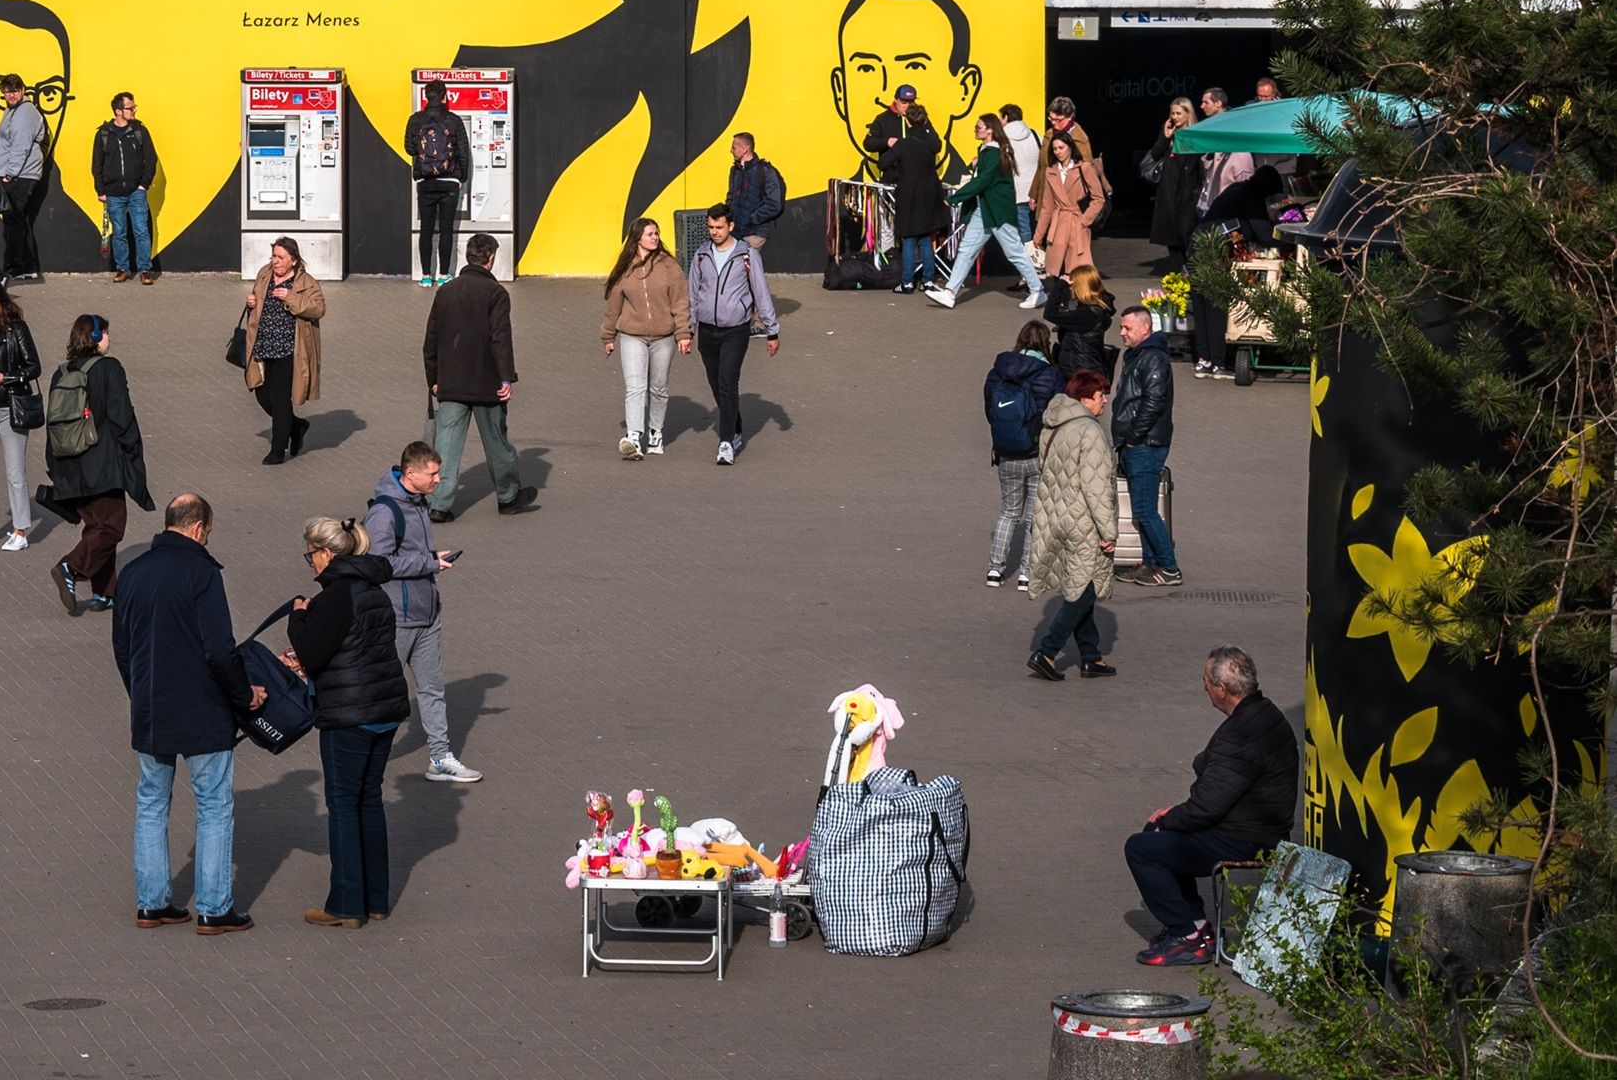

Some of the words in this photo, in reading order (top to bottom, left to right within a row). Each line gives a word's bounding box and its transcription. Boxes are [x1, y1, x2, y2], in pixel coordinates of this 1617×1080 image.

[243, 12, 298, 26] Łazarz
[307, 12, 359, 26] Menes
[422, 71, 445, 80] Bilety
[451, 71, 477, 79] Tickets
[252, 88, 289, 103] Bilety
[255, 717, 284, 741] LUISS
